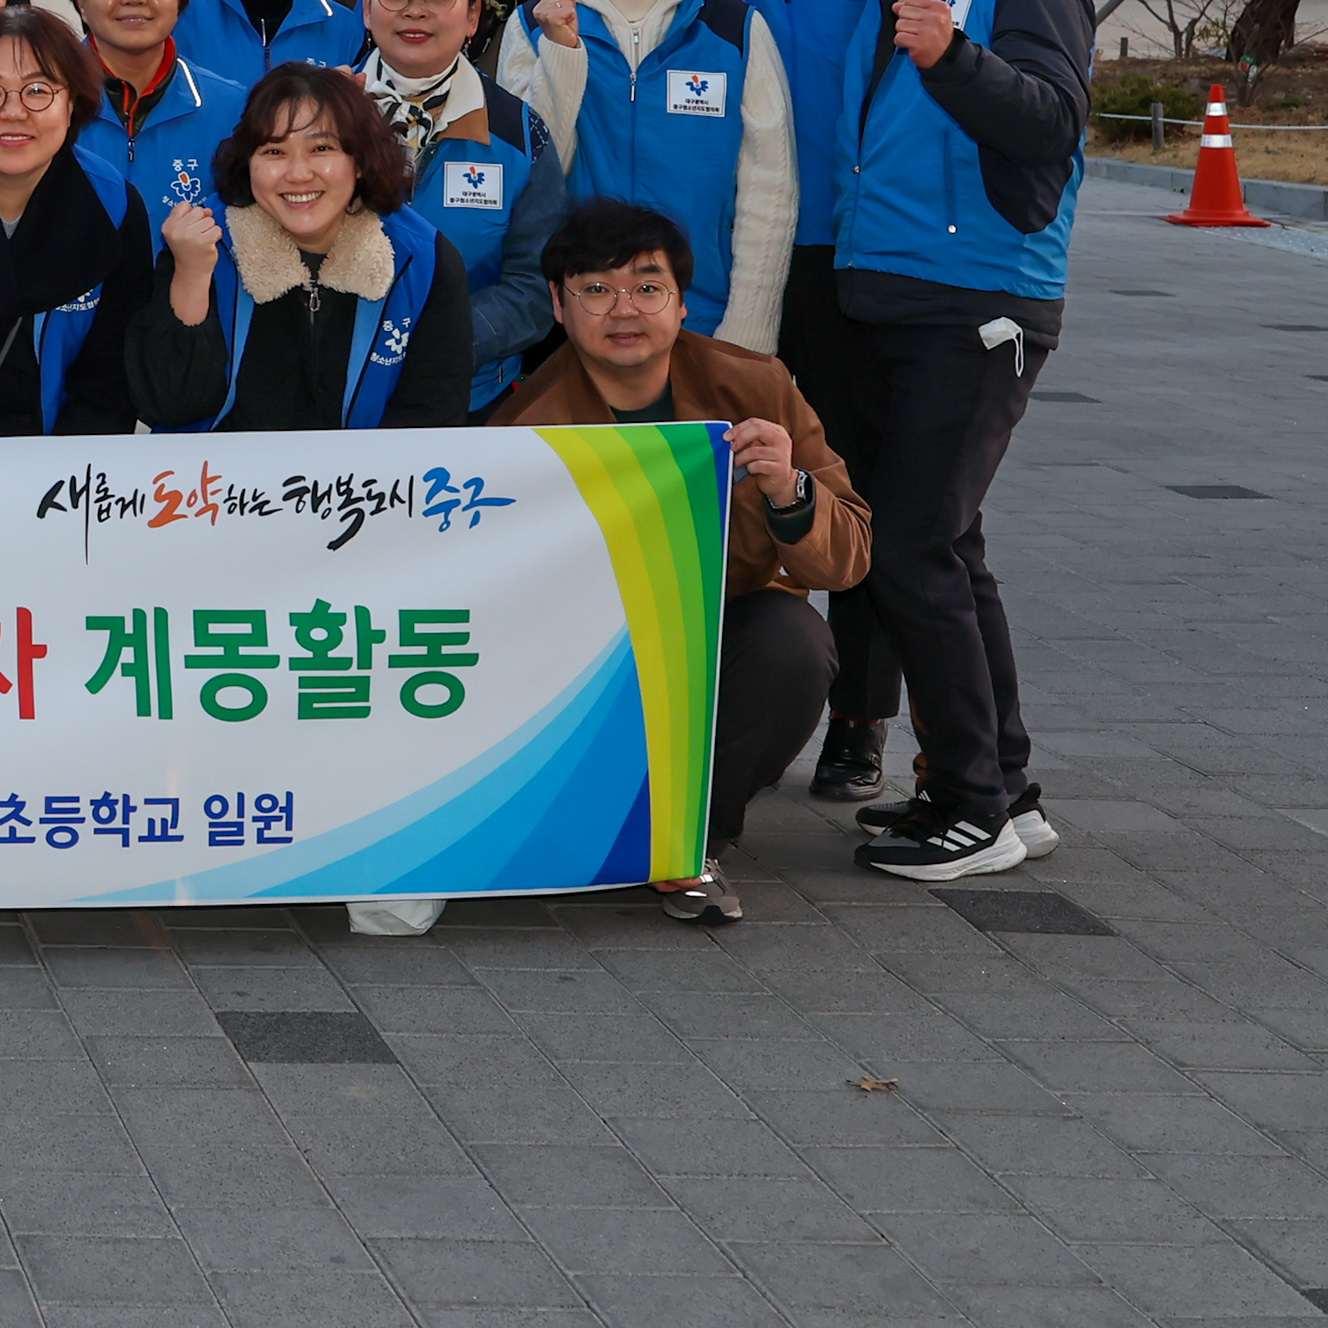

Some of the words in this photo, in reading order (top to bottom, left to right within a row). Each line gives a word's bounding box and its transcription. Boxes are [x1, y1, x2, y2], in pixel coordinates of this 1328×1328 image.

[37, 463, 146, 566] 새롭게
[281, 472, 414, 552] 행복도시
[422, 466, 517, 533] 중구
[85, 598, 480, 723] 계몽활동
[204, 791, 294, 847] 일원
